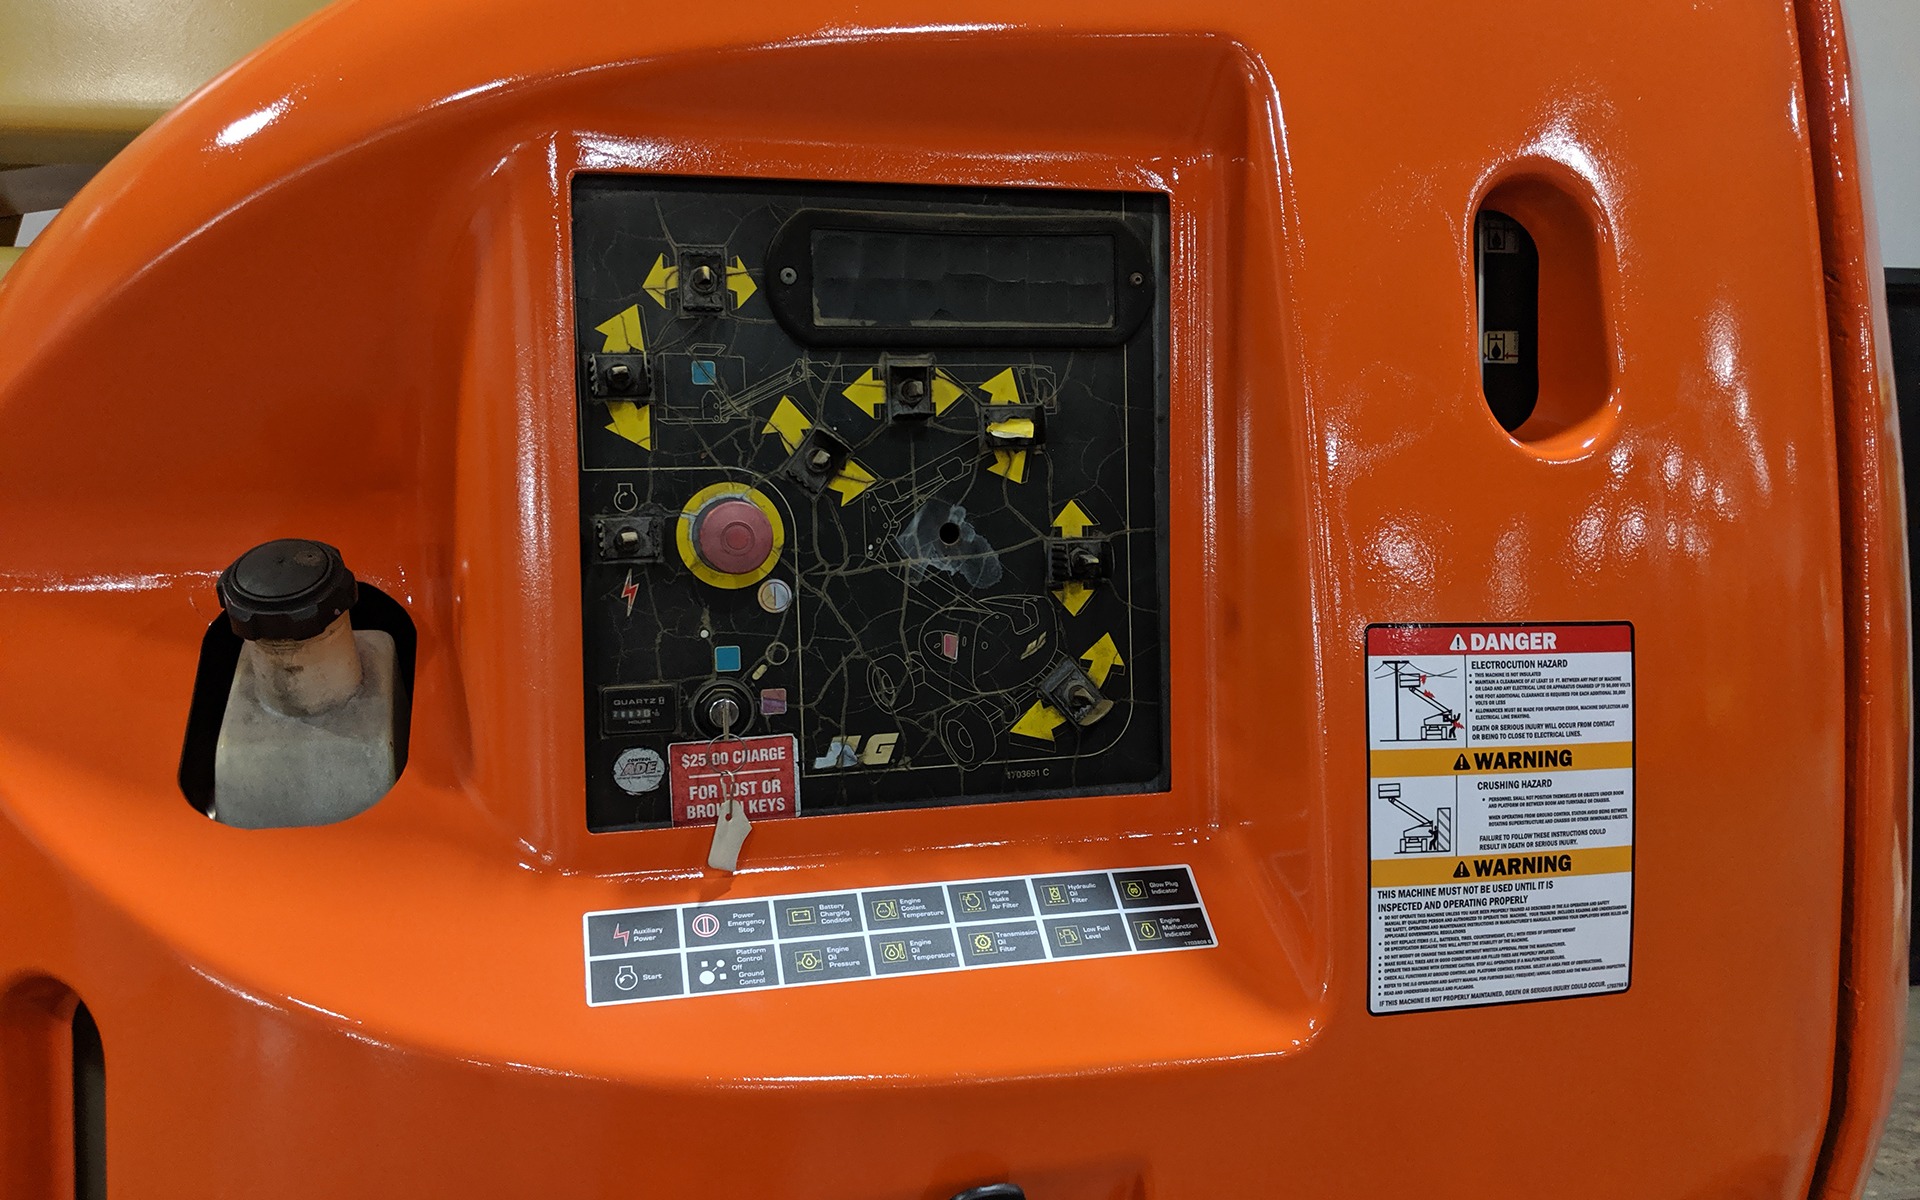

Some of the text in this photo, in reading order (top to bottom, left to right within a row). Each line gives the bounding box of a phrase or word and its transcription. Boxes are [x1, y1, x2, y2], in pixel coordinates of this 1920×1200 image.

[1471, 632, 1556, 651] DANGER
[1471, 659, 1568, 669] ELECTROCUTION HAZARD
[732, 746, 786, 764] CHARGE
[816, 732, 900, 768] JLG
[1474, 750, 1572, 770] WARNING
[620, 761, 658, 776] ADE
[1043, 768, 1050, 776] C
[689, 784, 718, 800] FOR
[762, 779, 781, 794] OR
[1477, 779, 1552, 790] CRUSHING HAZARD
[748, 797, 786, 814] KEYS
[1479, 834, 1502, 842] FAILURE
[1511, 832, 1532, 840] FOLLOW
[1551, 829, 1588, 837] INSTRUCTIONS
[1474, 856, 1571, 876] WARNING
[1067, 883, 1096, 892] Hydraulic
[1149, 880, 1178, 890] Glow Plug
[1378, 881, 1553, 899] THIS MACHINE MUST NOT BE USED UNTIL IT IS
[988, 890, 1009, 898] Engine
[899, 898, 921, 906] Engine
[1377, 895, 1527, 912] INSPECTED AND OPERATING PROPERLY
[819, 904, 844, 912] Battery
[820, 910, 850, 918] Charging
[902, 910, 944, 918] Temperature
[727, 919, 765, 928] Emergency
[1159, 917, 1180, 926] Engine
[909, 940, 931, 948] Engine
[736, 947, 766, 955] Platform
[826, 946, 849, 955] Engine
[912, 952, 956, 960] Temperature
[1398, 997, 1424, 1005] MACHINE
[1443, 993, 1469, 1001] PROPERLY
[1470, 990, 1503, 999] MAINTAINED,
[1570, 982, 1587, 990] COULD
